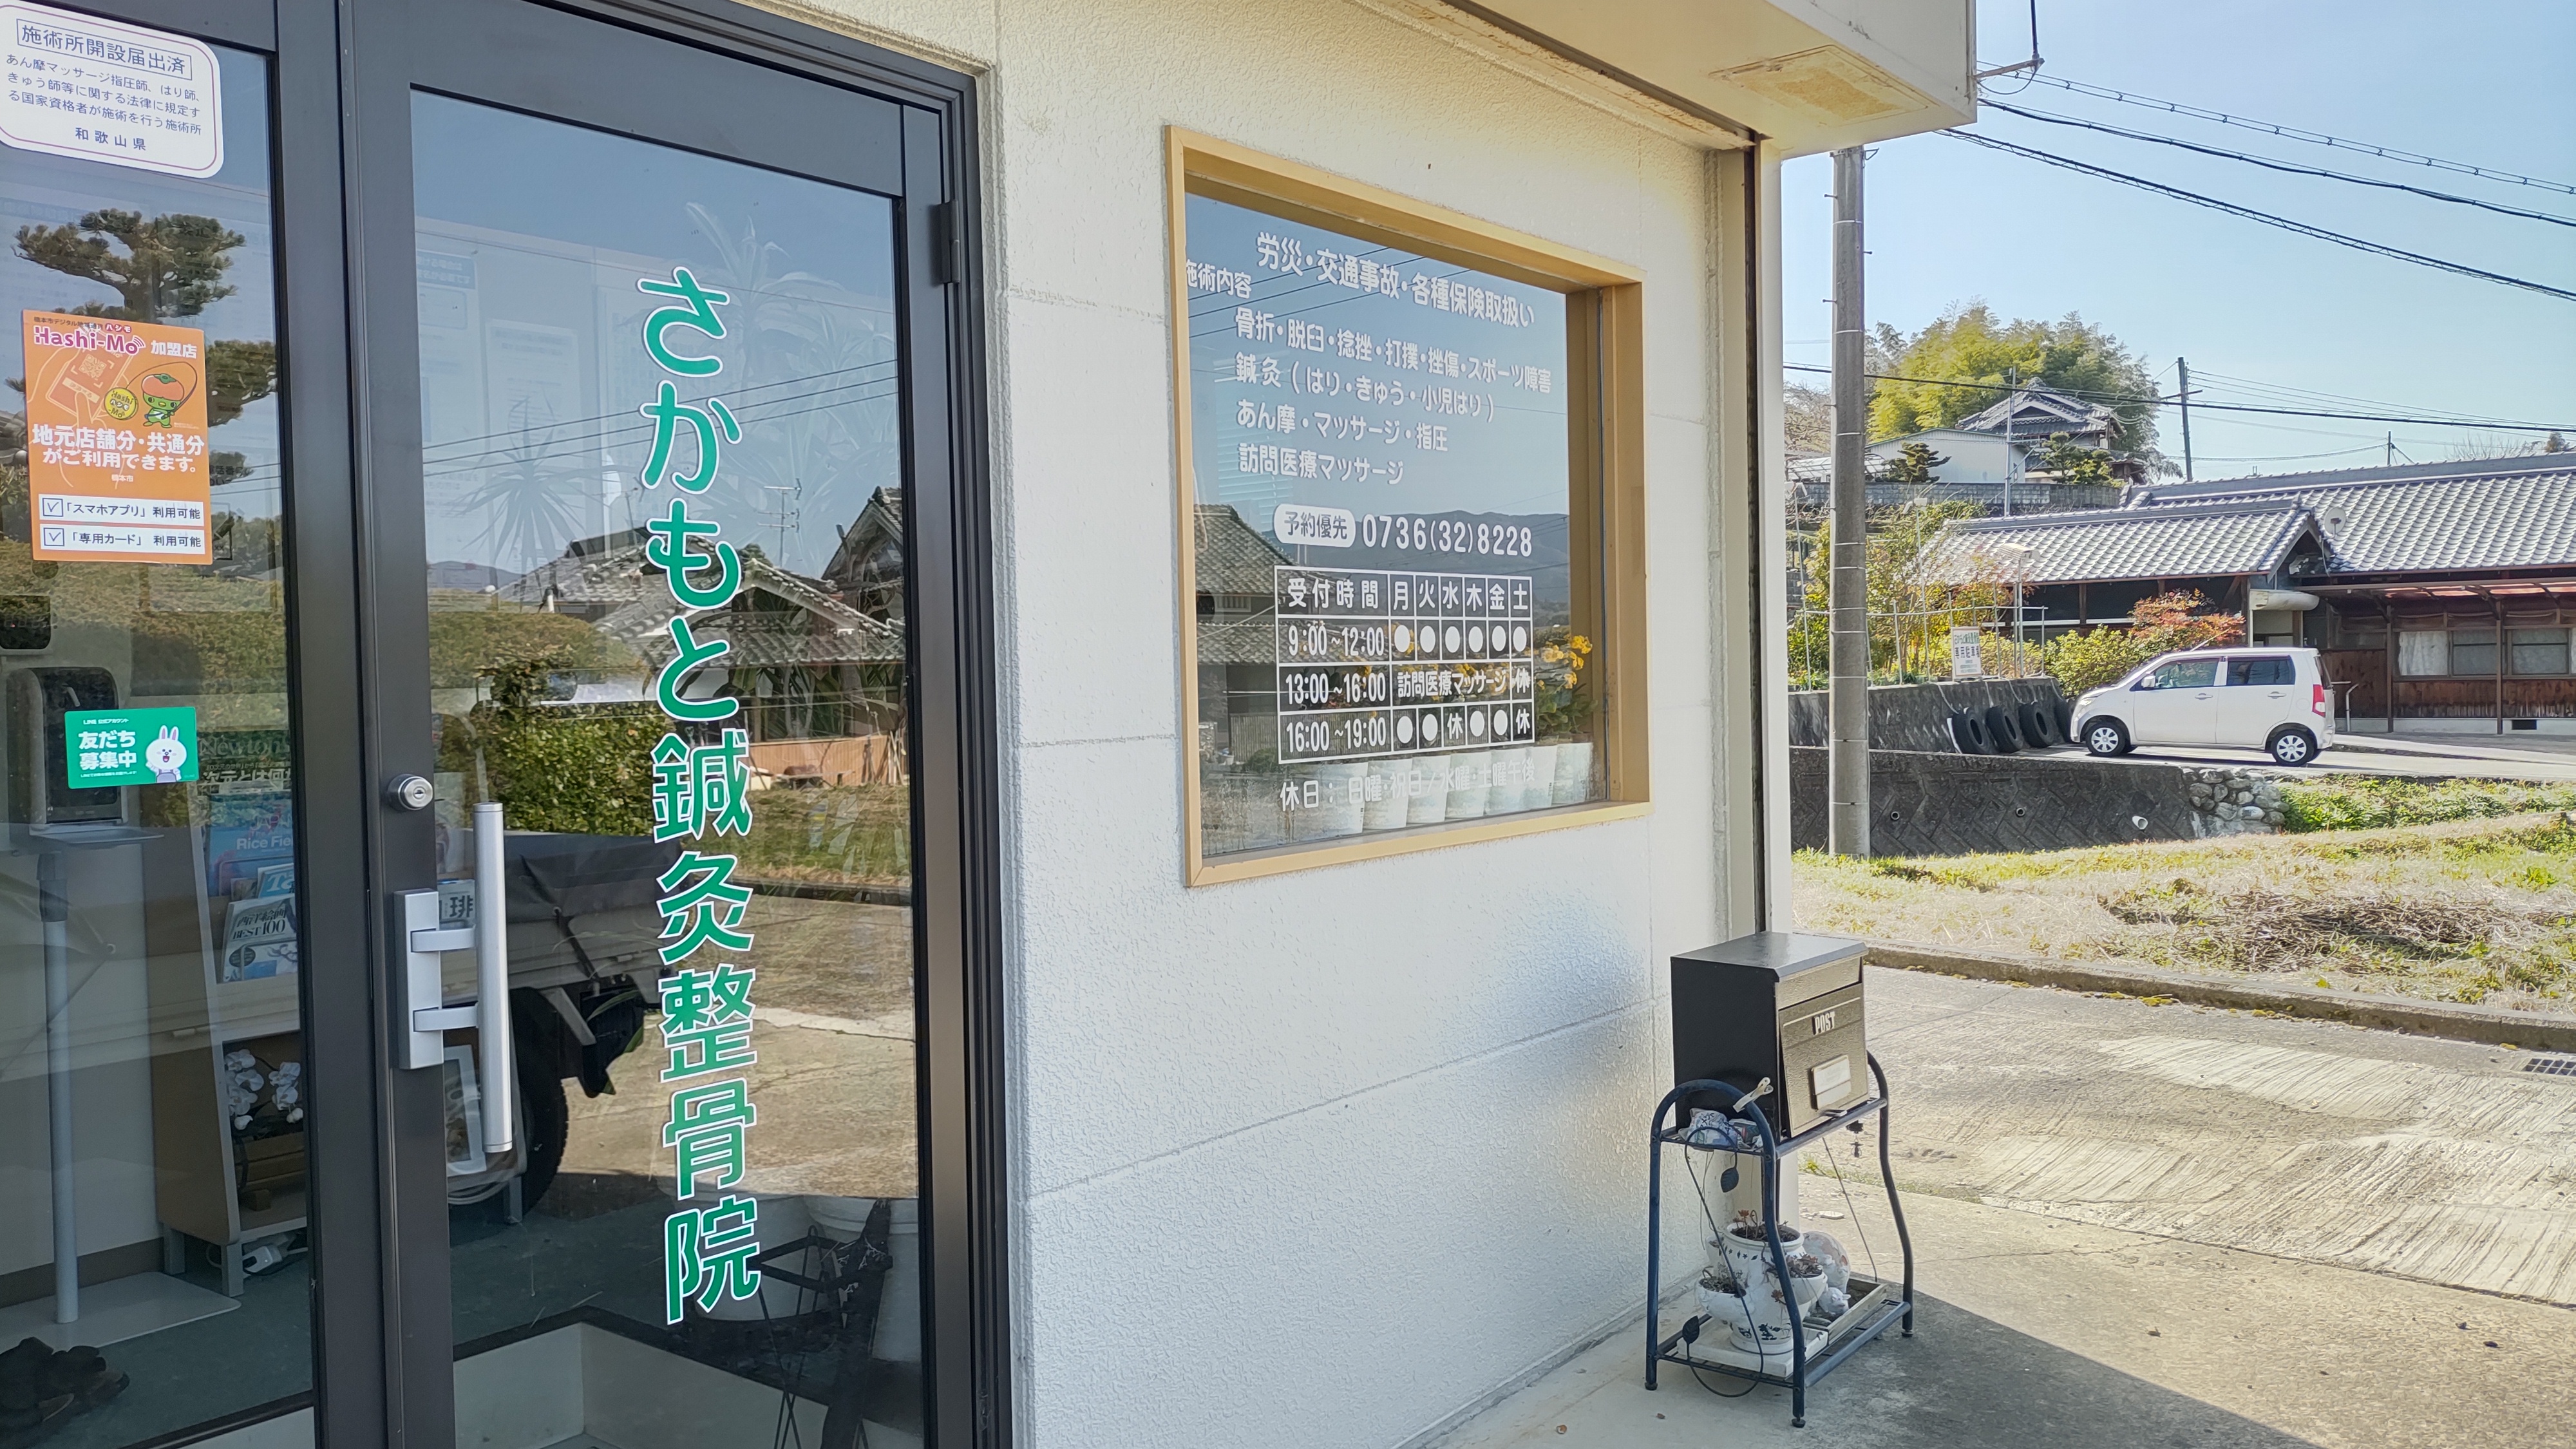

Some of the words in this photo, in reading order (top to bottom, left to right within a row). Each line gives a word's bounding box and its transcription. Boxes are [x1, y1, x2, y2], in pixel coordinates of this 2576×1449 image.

[21, 24, 185, 75] 施術所開設届出済
[7, 72, 200, 118] きゅう師等に関する法律に規定す
[8, 90, 202, 135] る国家資格者が施術を行う施術所
[75, 127, 146, 151] 和歌山県
[1256, 232, 1535, 328] 労災・交通事故・各種保険取扱い
[33, 325, 140, 356] Hashi-Mo
[151, 340, 197, 359] 加盟店
[1235, 307, 1551, 394] 骨折・脱臼・捻挫・打撲・挫傷・スポーツ障害
[32, 423, 205, 456] 地元店舗分・共通分
[1236, 399, 1449, 452] あん摩・マッサージ・指圧
[43, 449, 196, 473] がご利用できます。
[1238, 442, 1404, 485] 訪問医療マッサージ
[66, 502, 146, 518] 「スマホアプリ」
[153, 505, 201, 520] 利用可能
[1284, 511, 1349, 541] 予約優先
[73, 532, 142, 546] 「専用カード」
[153, 535, 202, 548] 利用可能
[1362, 514, 1532, 557] 0736(32)8228
[1287, 578, 1379, 611] 受付時間
[1393, 581, 1409, 611] 月
[1418, 580, 1436, 609] 火
[1443, 581, 1459, 610] 水
[1466, 583, 1482, 611] 木
[1489, 583, 1506, 611] 金
[1513, 583, 1529, 611] 土
[1397, 670, 1507, 699] 訪問医療マッサージ
[1515, 667, 1531, 693] 休
[78, 729, 136, 749] 友だち
[1447, 713, 1464, 740] 休
[1516, 708, 1530, 735] 休
[79, 750, 137, 770] 募集中
[636, 265, 762, 1325] さかもと鍼灸整骨院
[236, 838, 269, 850] Rice
[232, 926, 261, 940] BEST
[262, 919, 285, 935] 100
[1815, 1011, 1835, 1036] POST
